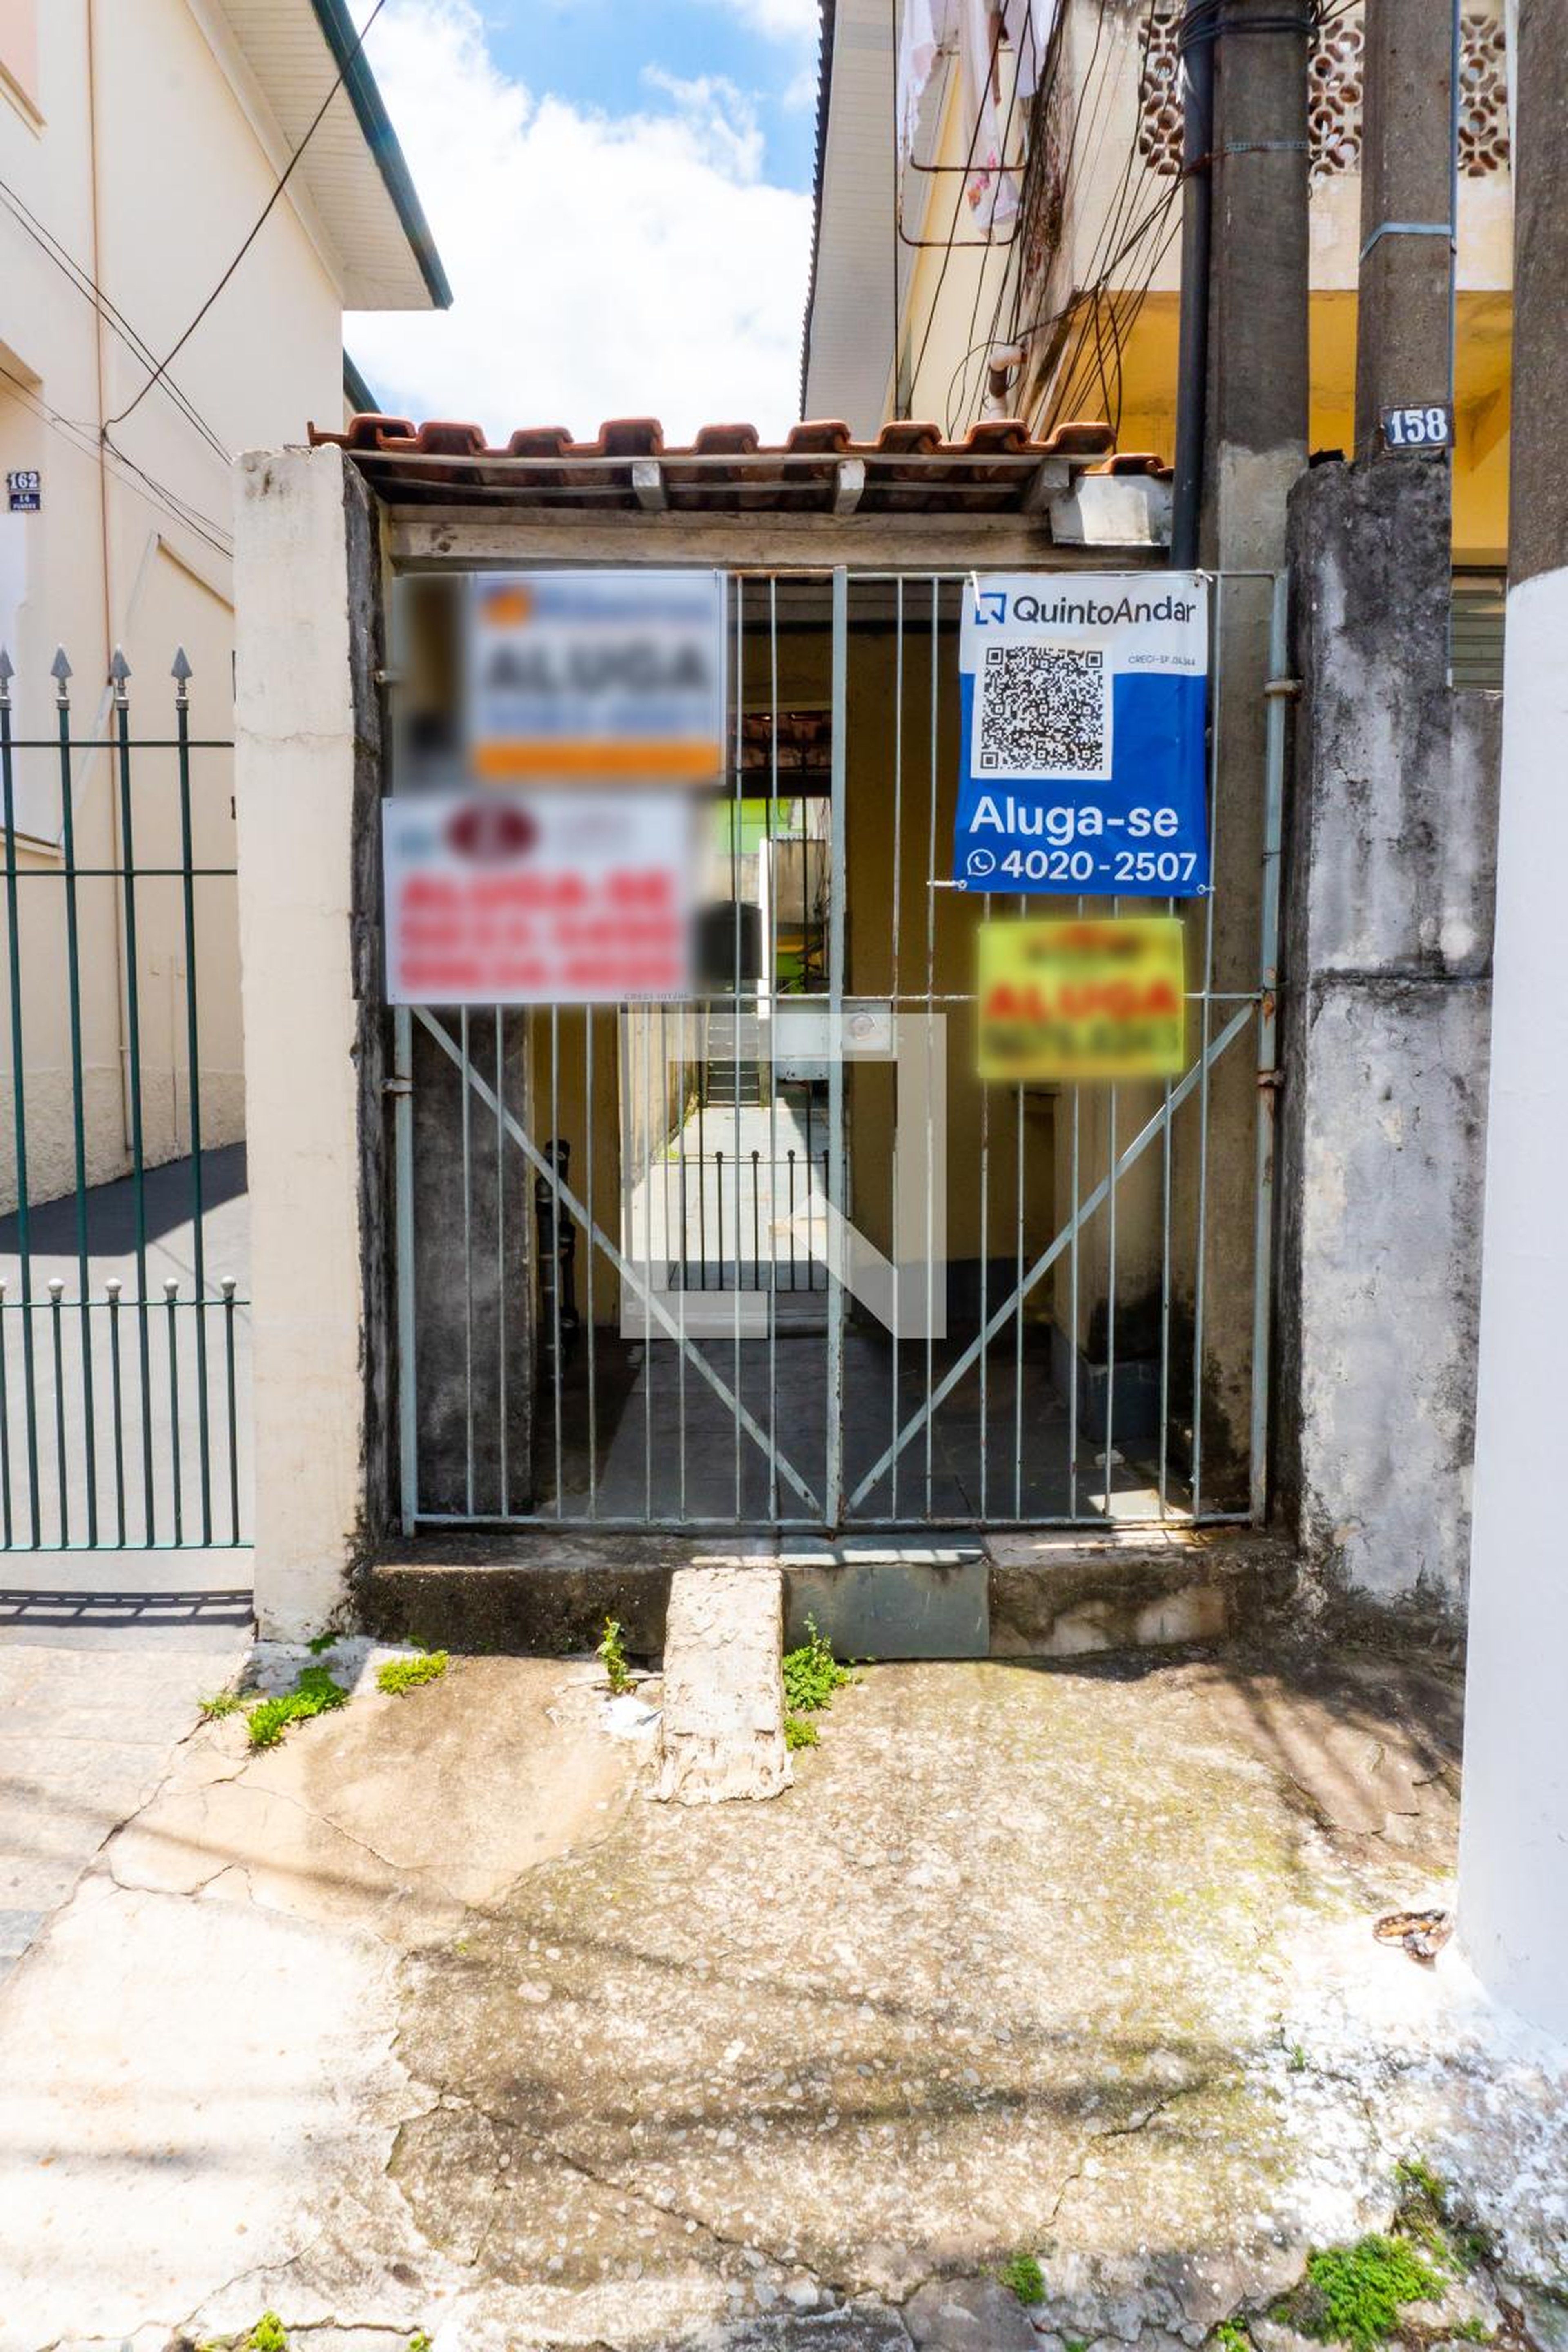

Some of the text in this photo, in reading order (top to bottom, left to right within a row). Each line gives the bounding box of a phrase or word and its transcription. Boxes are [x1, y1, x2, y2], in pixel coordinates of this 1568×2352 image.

[1391, 408, 1448, 444] 158
[10, 472, 38, 489] 162
[1013, 595, 1196, 626] QuintoAndar
[969, 795, 1179, 846] Aluga-se
[1001, 849, 1197, 882] 4020-2507
